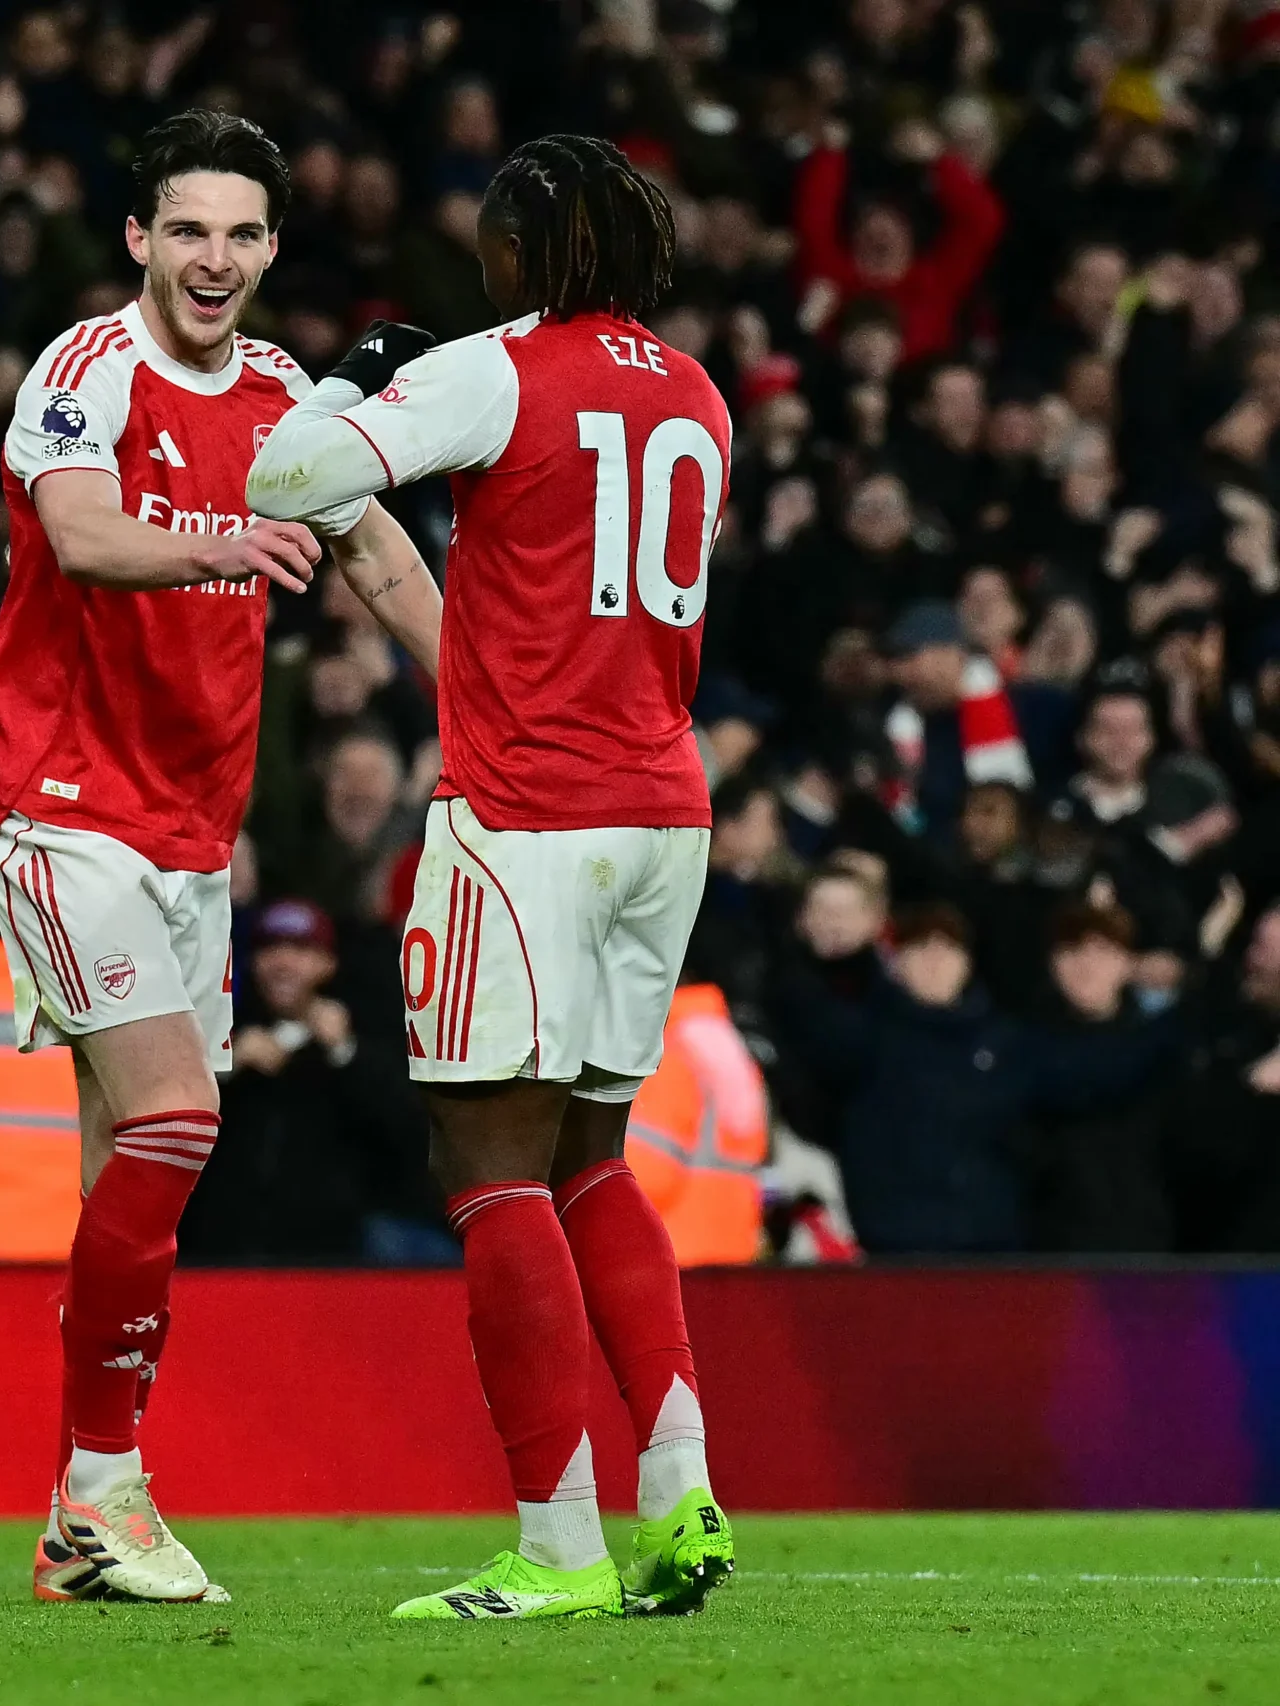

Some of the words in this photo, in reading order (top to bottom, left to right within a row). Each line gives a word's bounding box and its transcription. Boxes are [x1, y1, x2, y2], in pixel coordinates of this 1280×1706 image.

[596, 333, 668, 376] EZE
[42, 442, 60, 453] No
[62, 443, 101, 456] racm
[576, 411, 722, 628] 10
[100, 960, 128, 973] Arsenal
